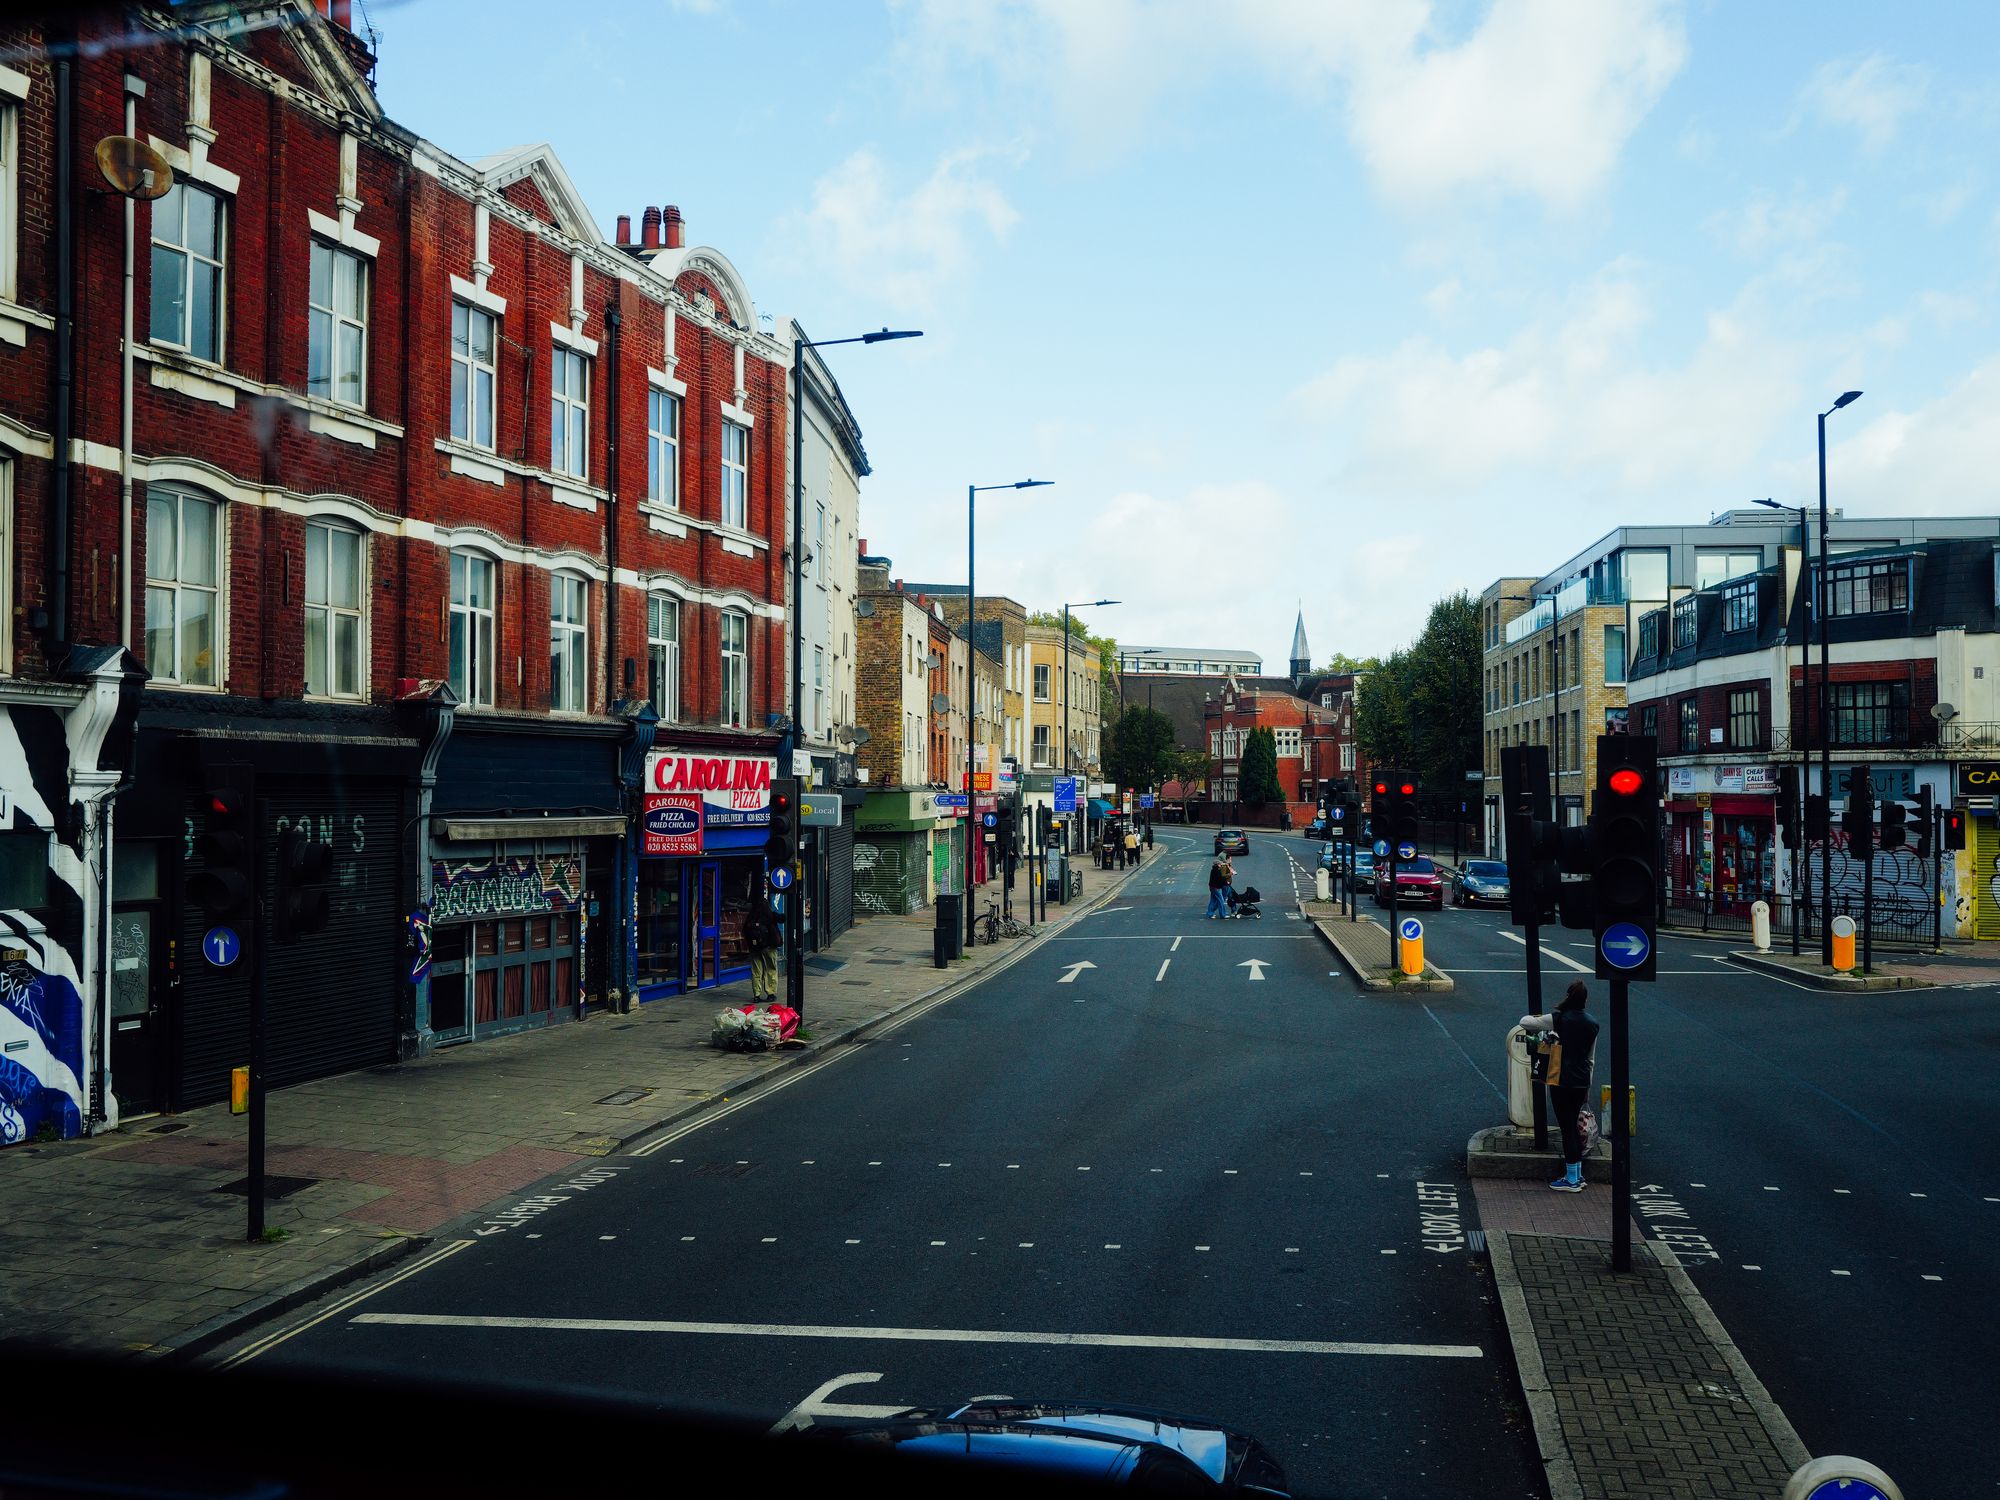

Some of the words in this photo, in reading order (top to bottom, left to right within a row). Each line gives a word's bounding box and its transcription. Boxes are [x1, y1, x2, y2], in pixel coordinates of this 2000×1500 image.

[655, 757, 771, 791] CAROLINA
[649, 797, 696, 809] CAROLINA
[732, 791, 761, 809] PIZZA
[660, 813, 684, 821] PIZZA
[707, 814, 721, 824] FREE
[721, 813, 744, 823] DELIVERY
[814, 807, 835, 816] Local
[649, 821, 668, 829] FRIED
[668, 821, 695, 829] CHICKEN
[647, 843, 661, 851] 020
[662, 843, 679, 851] 8525
[680, 843, 697, 851] 5588
[552, 1166, 631, 1192] LOOK
[1416, 1181, 1459, 1208] LEFT
[483, 1195, 573, 1228] RIGHT
[1629, 1193, 1691, 1219] LOOK
[1420, 1212, 1464, 1243] LOOK
[1651, 1225, 1720, 1260] LEFT
